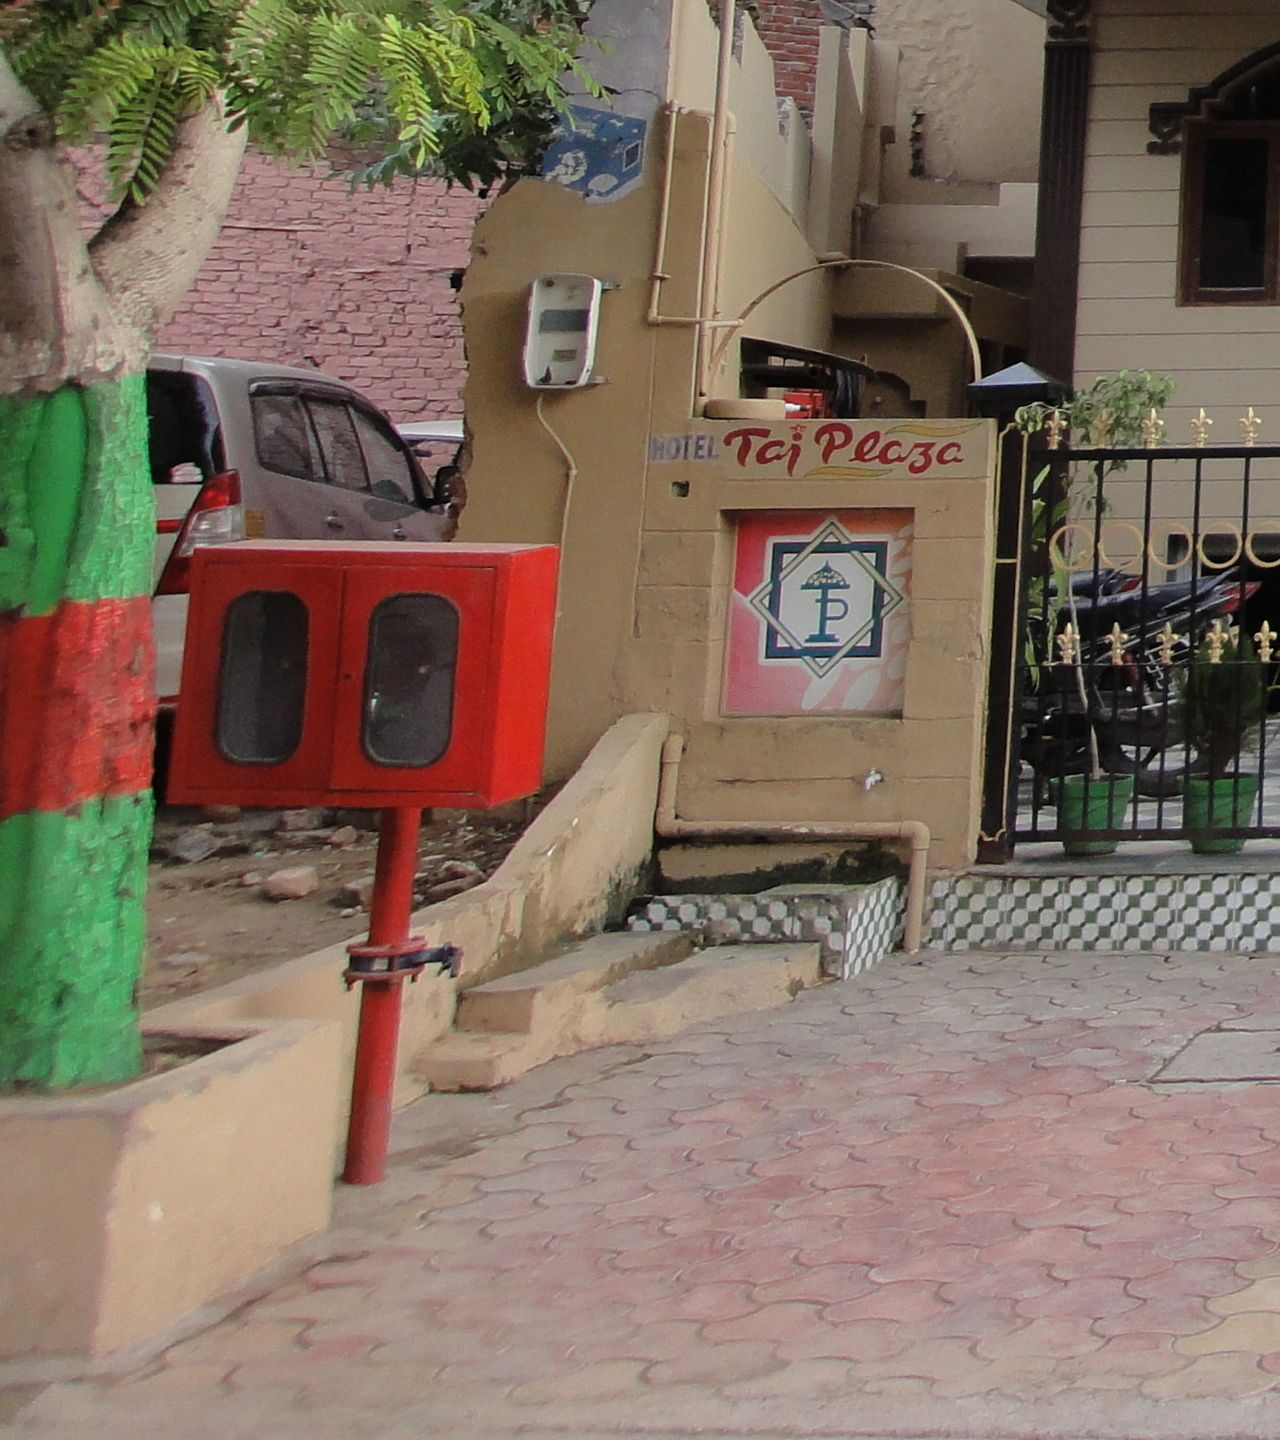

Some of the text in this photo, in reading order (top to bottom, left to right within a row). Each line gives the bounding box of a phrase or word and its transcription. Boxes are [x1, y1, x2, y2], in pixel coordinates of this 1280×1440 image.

[651, 422, 965, 477] HOTEL Taj Plaza
